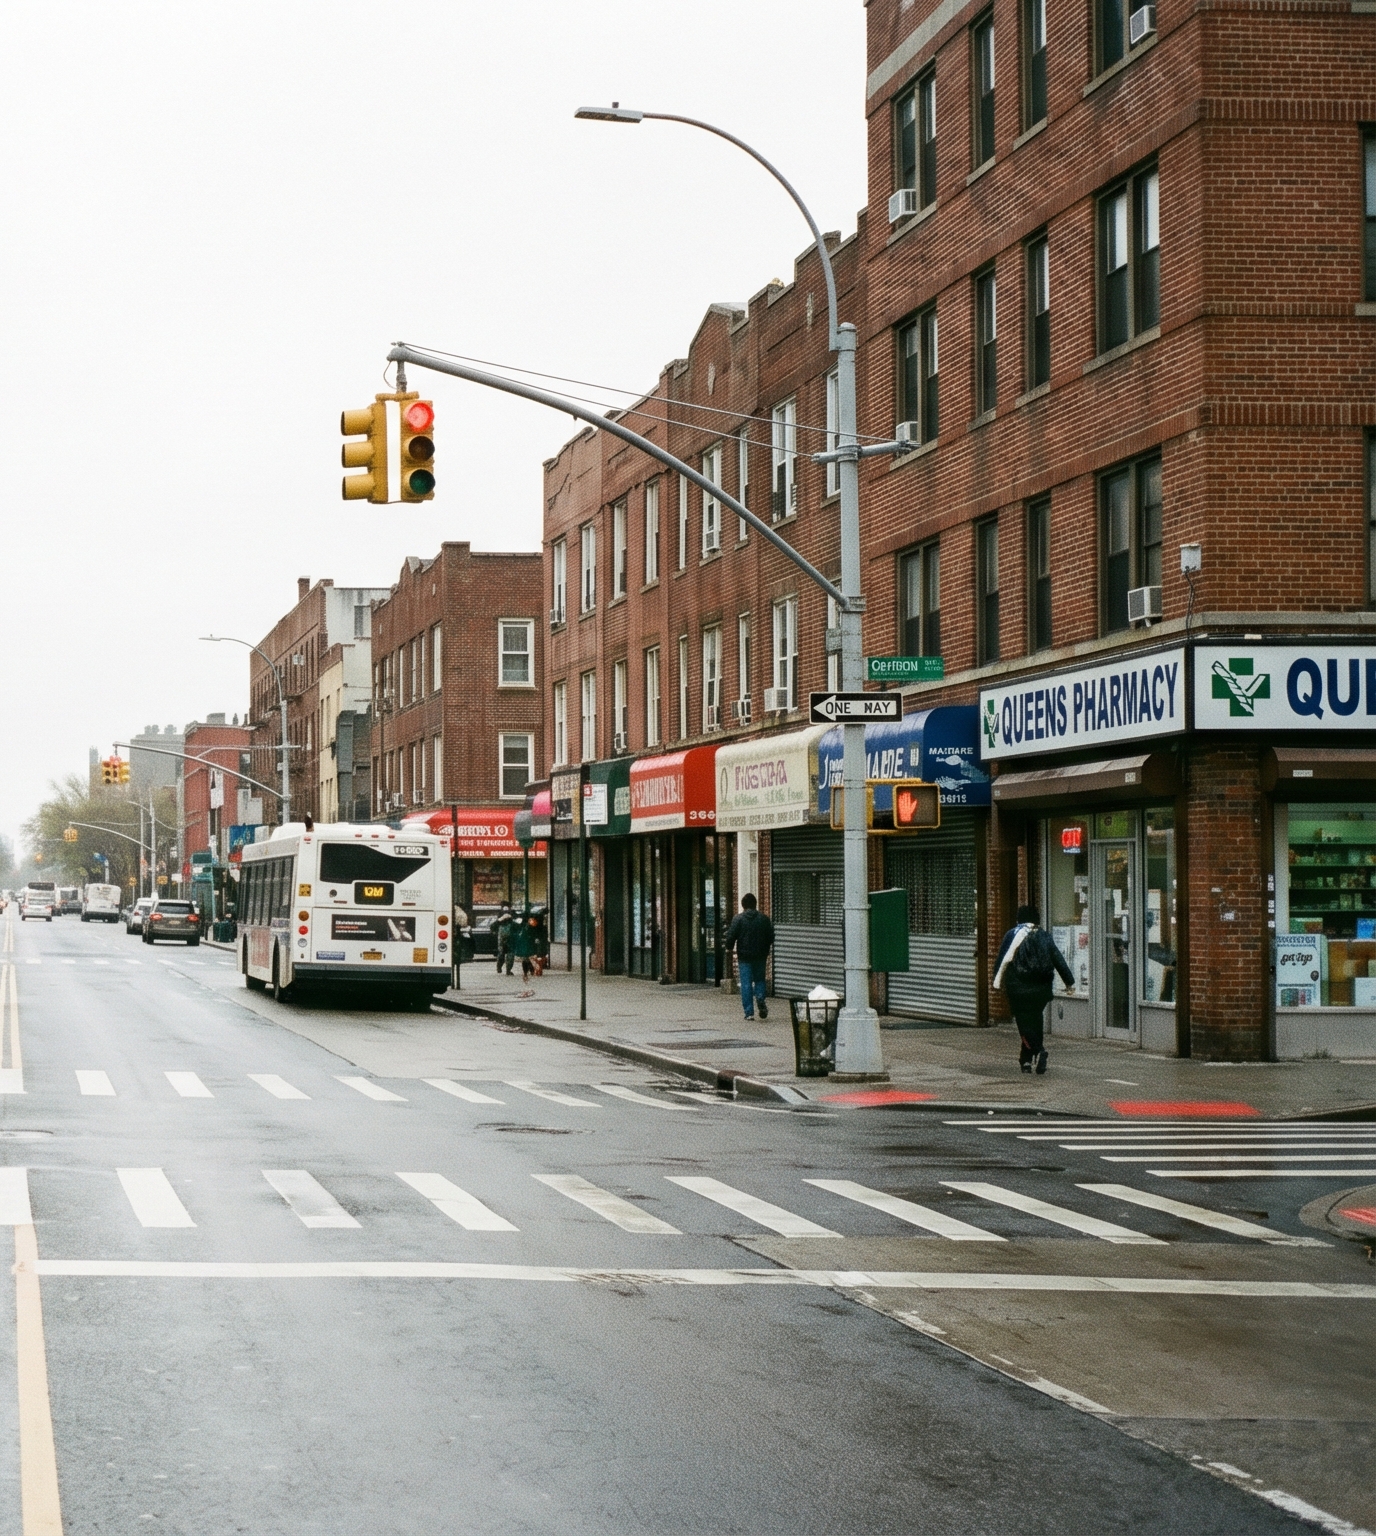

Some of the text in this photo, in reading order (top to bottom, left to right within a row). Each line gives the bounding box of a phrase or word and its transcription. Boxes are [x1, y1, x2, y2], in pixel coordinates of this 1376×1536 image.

[826, 702, 851, 714] ONE
[1002, 662, 1178, 747] QUEENS PHARMACY
